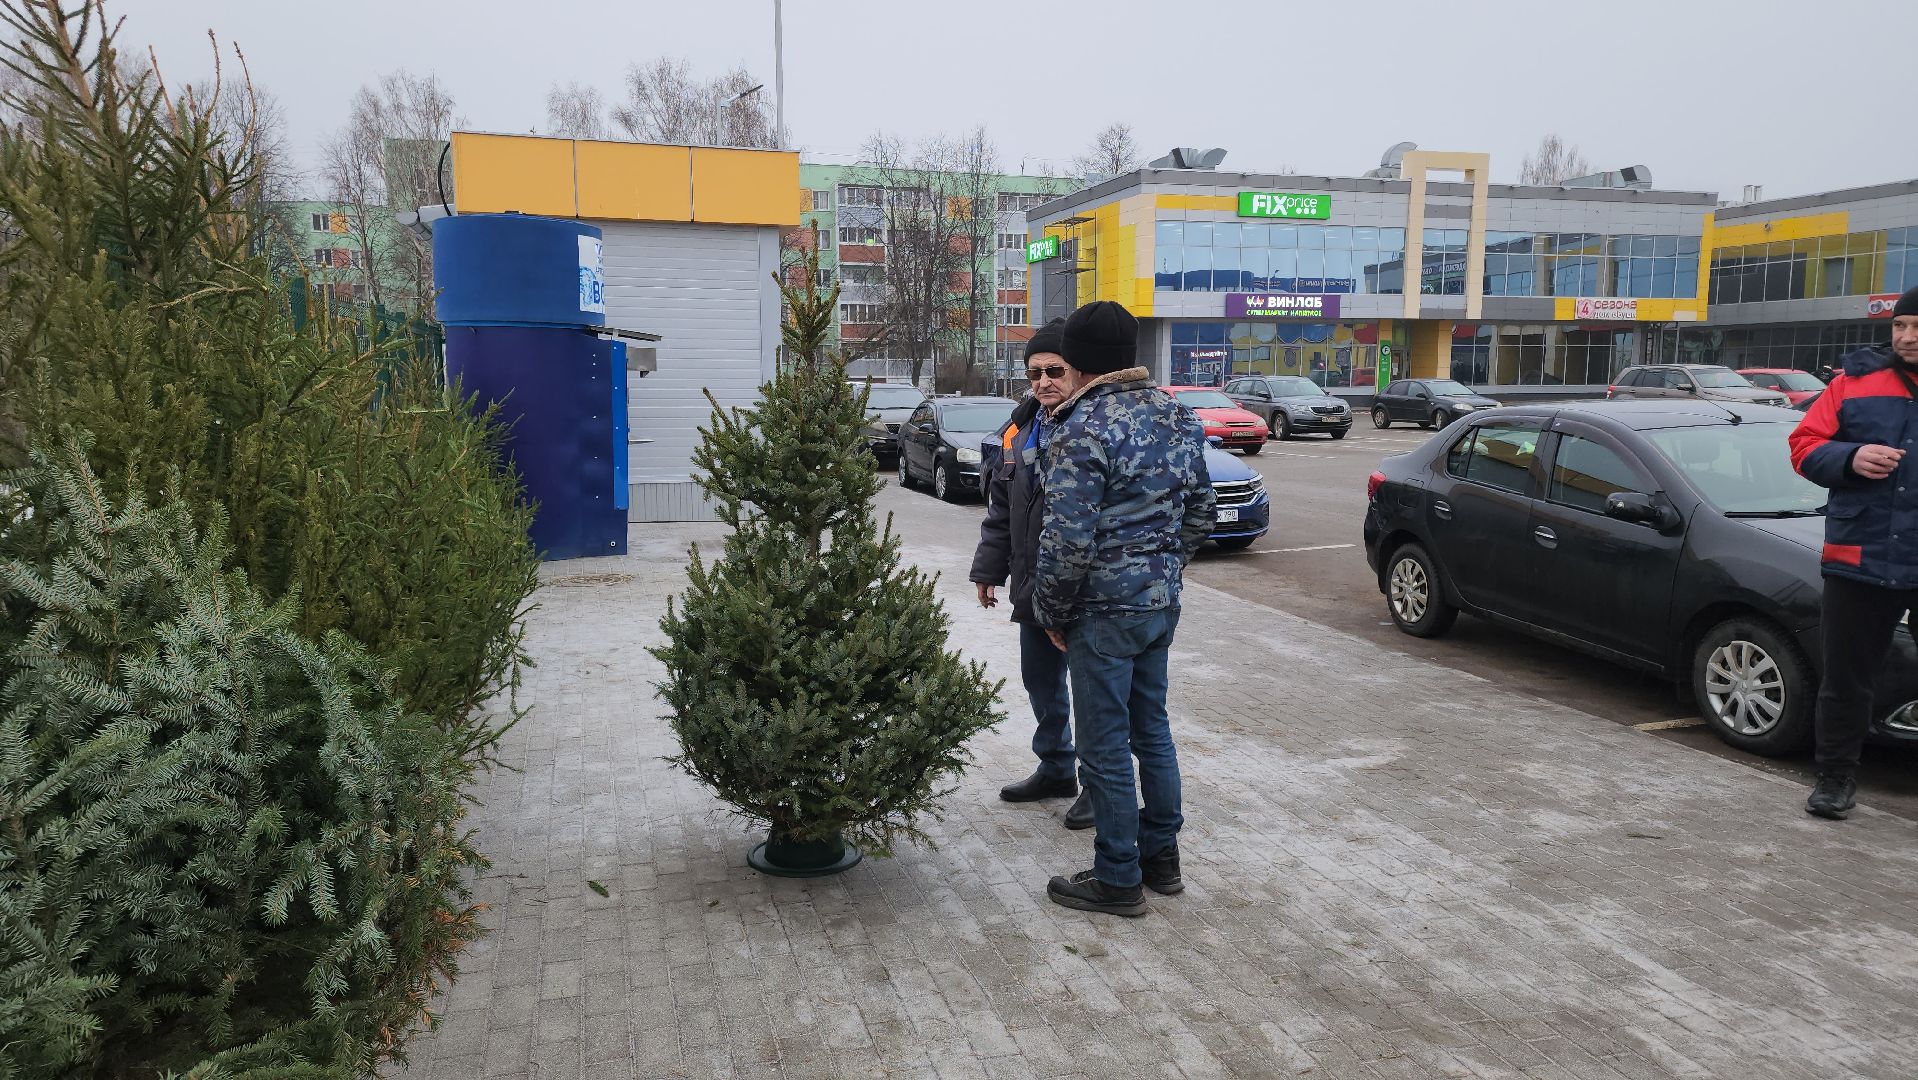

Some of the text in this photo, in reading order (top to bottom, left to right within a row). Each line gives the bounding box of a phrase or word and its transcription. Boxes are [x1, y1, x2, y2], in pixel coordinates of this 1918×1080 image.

[1252, 195, 1318, 215] FIX price
[1029, 243, 1042, 261] FIX
[1581, 301, 1589, 316] 4
